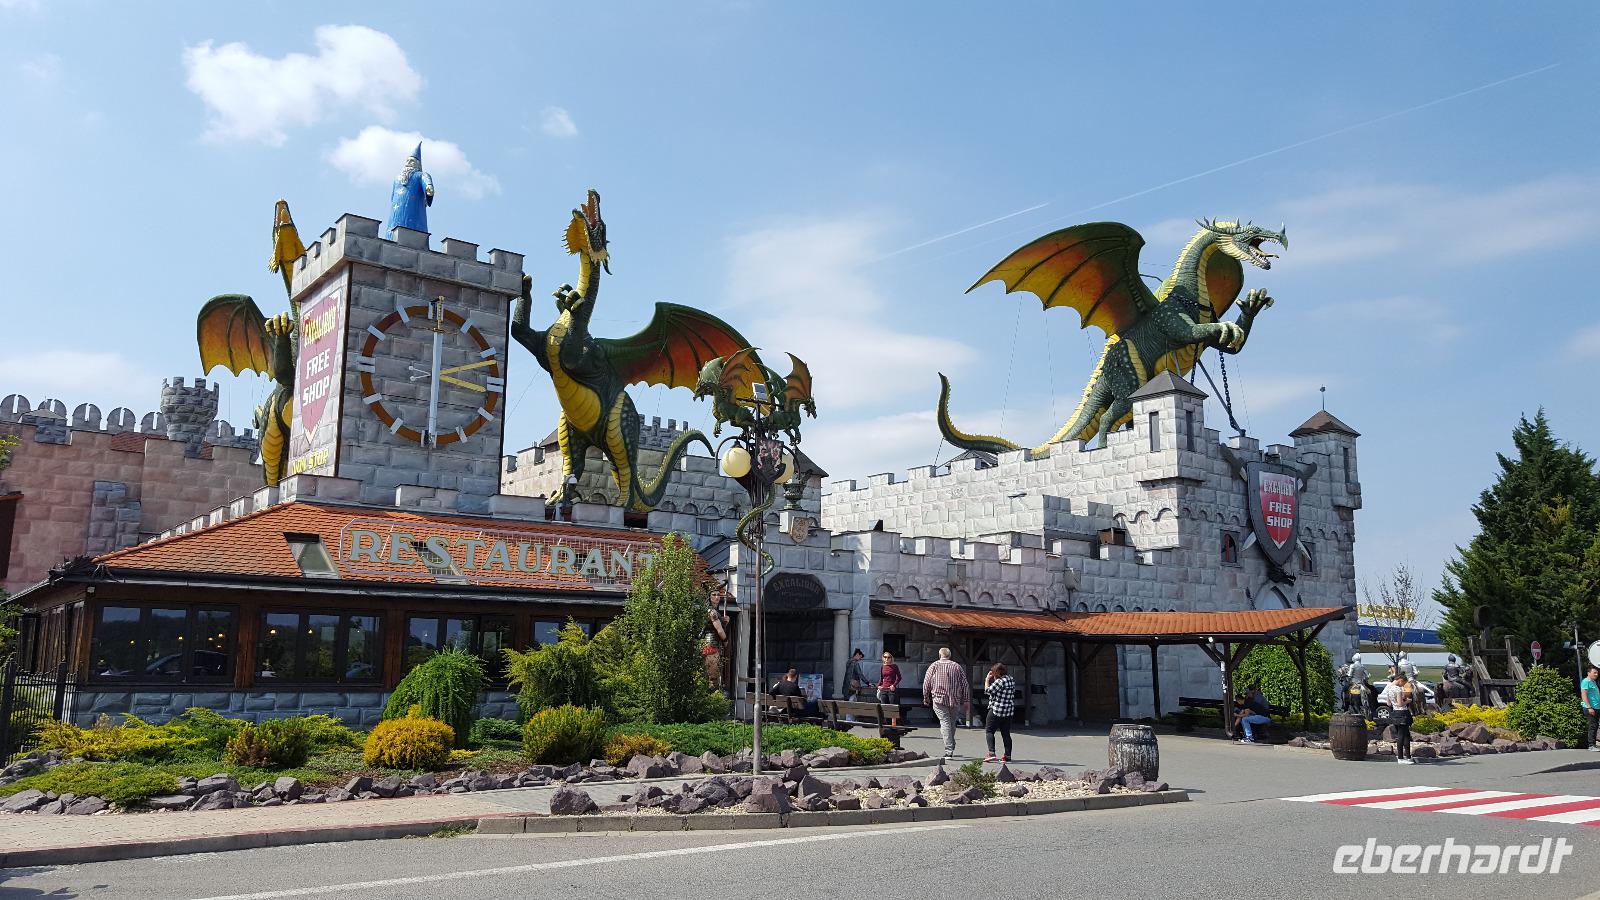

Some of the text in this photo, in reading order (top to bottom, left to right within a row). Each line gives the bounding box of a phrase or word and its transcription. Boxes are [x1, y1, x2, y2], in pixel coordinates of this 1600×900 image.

[305, 348, 331, 380] FREE
[302, 378, 331, 407] SHOP
[308, 448, 329, 469] STOP
[1269, 501, 1292, 515] FREE
[1266, 515, 1293, 529] SHOP
